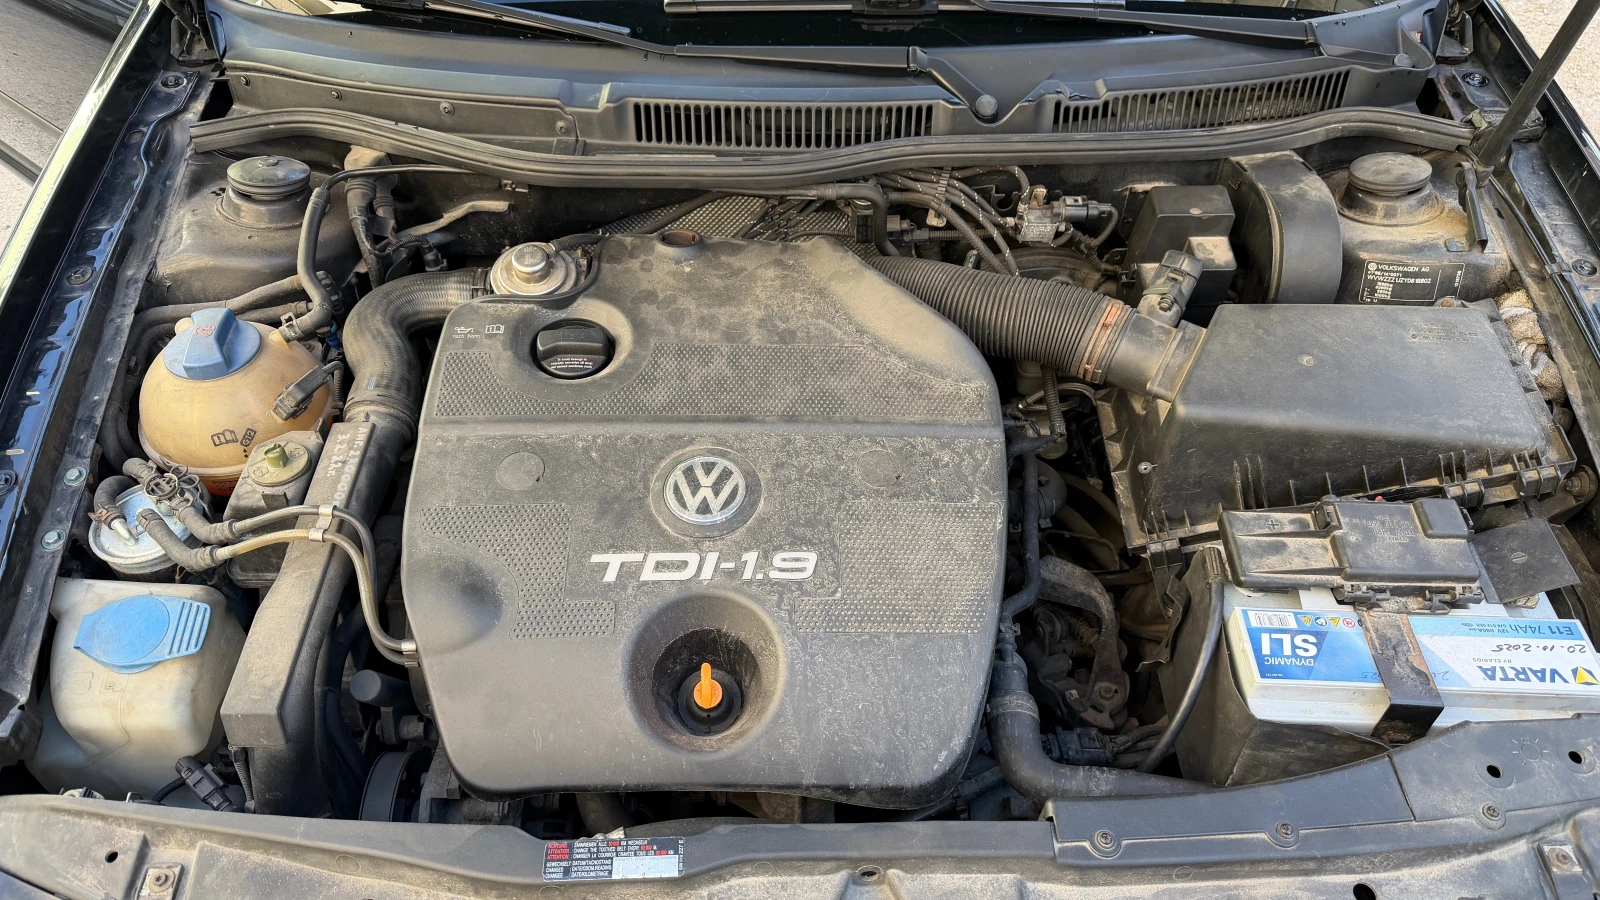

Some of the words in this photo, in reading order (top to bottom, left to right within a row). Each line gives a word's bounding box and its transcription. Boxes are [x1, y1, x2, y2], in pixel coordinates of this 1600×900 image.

[1378, 264, 1418, 272] VOLKSWAGEN
[1510, 624, 1546, 635] 74Ah
[1549, 625, 1574, 636] E11
[1261, 633, 1318, 657] SLI
[1264, 656, 1314, 667] DYNAMIC
[1477, 665, 1570, 684] VARTA
